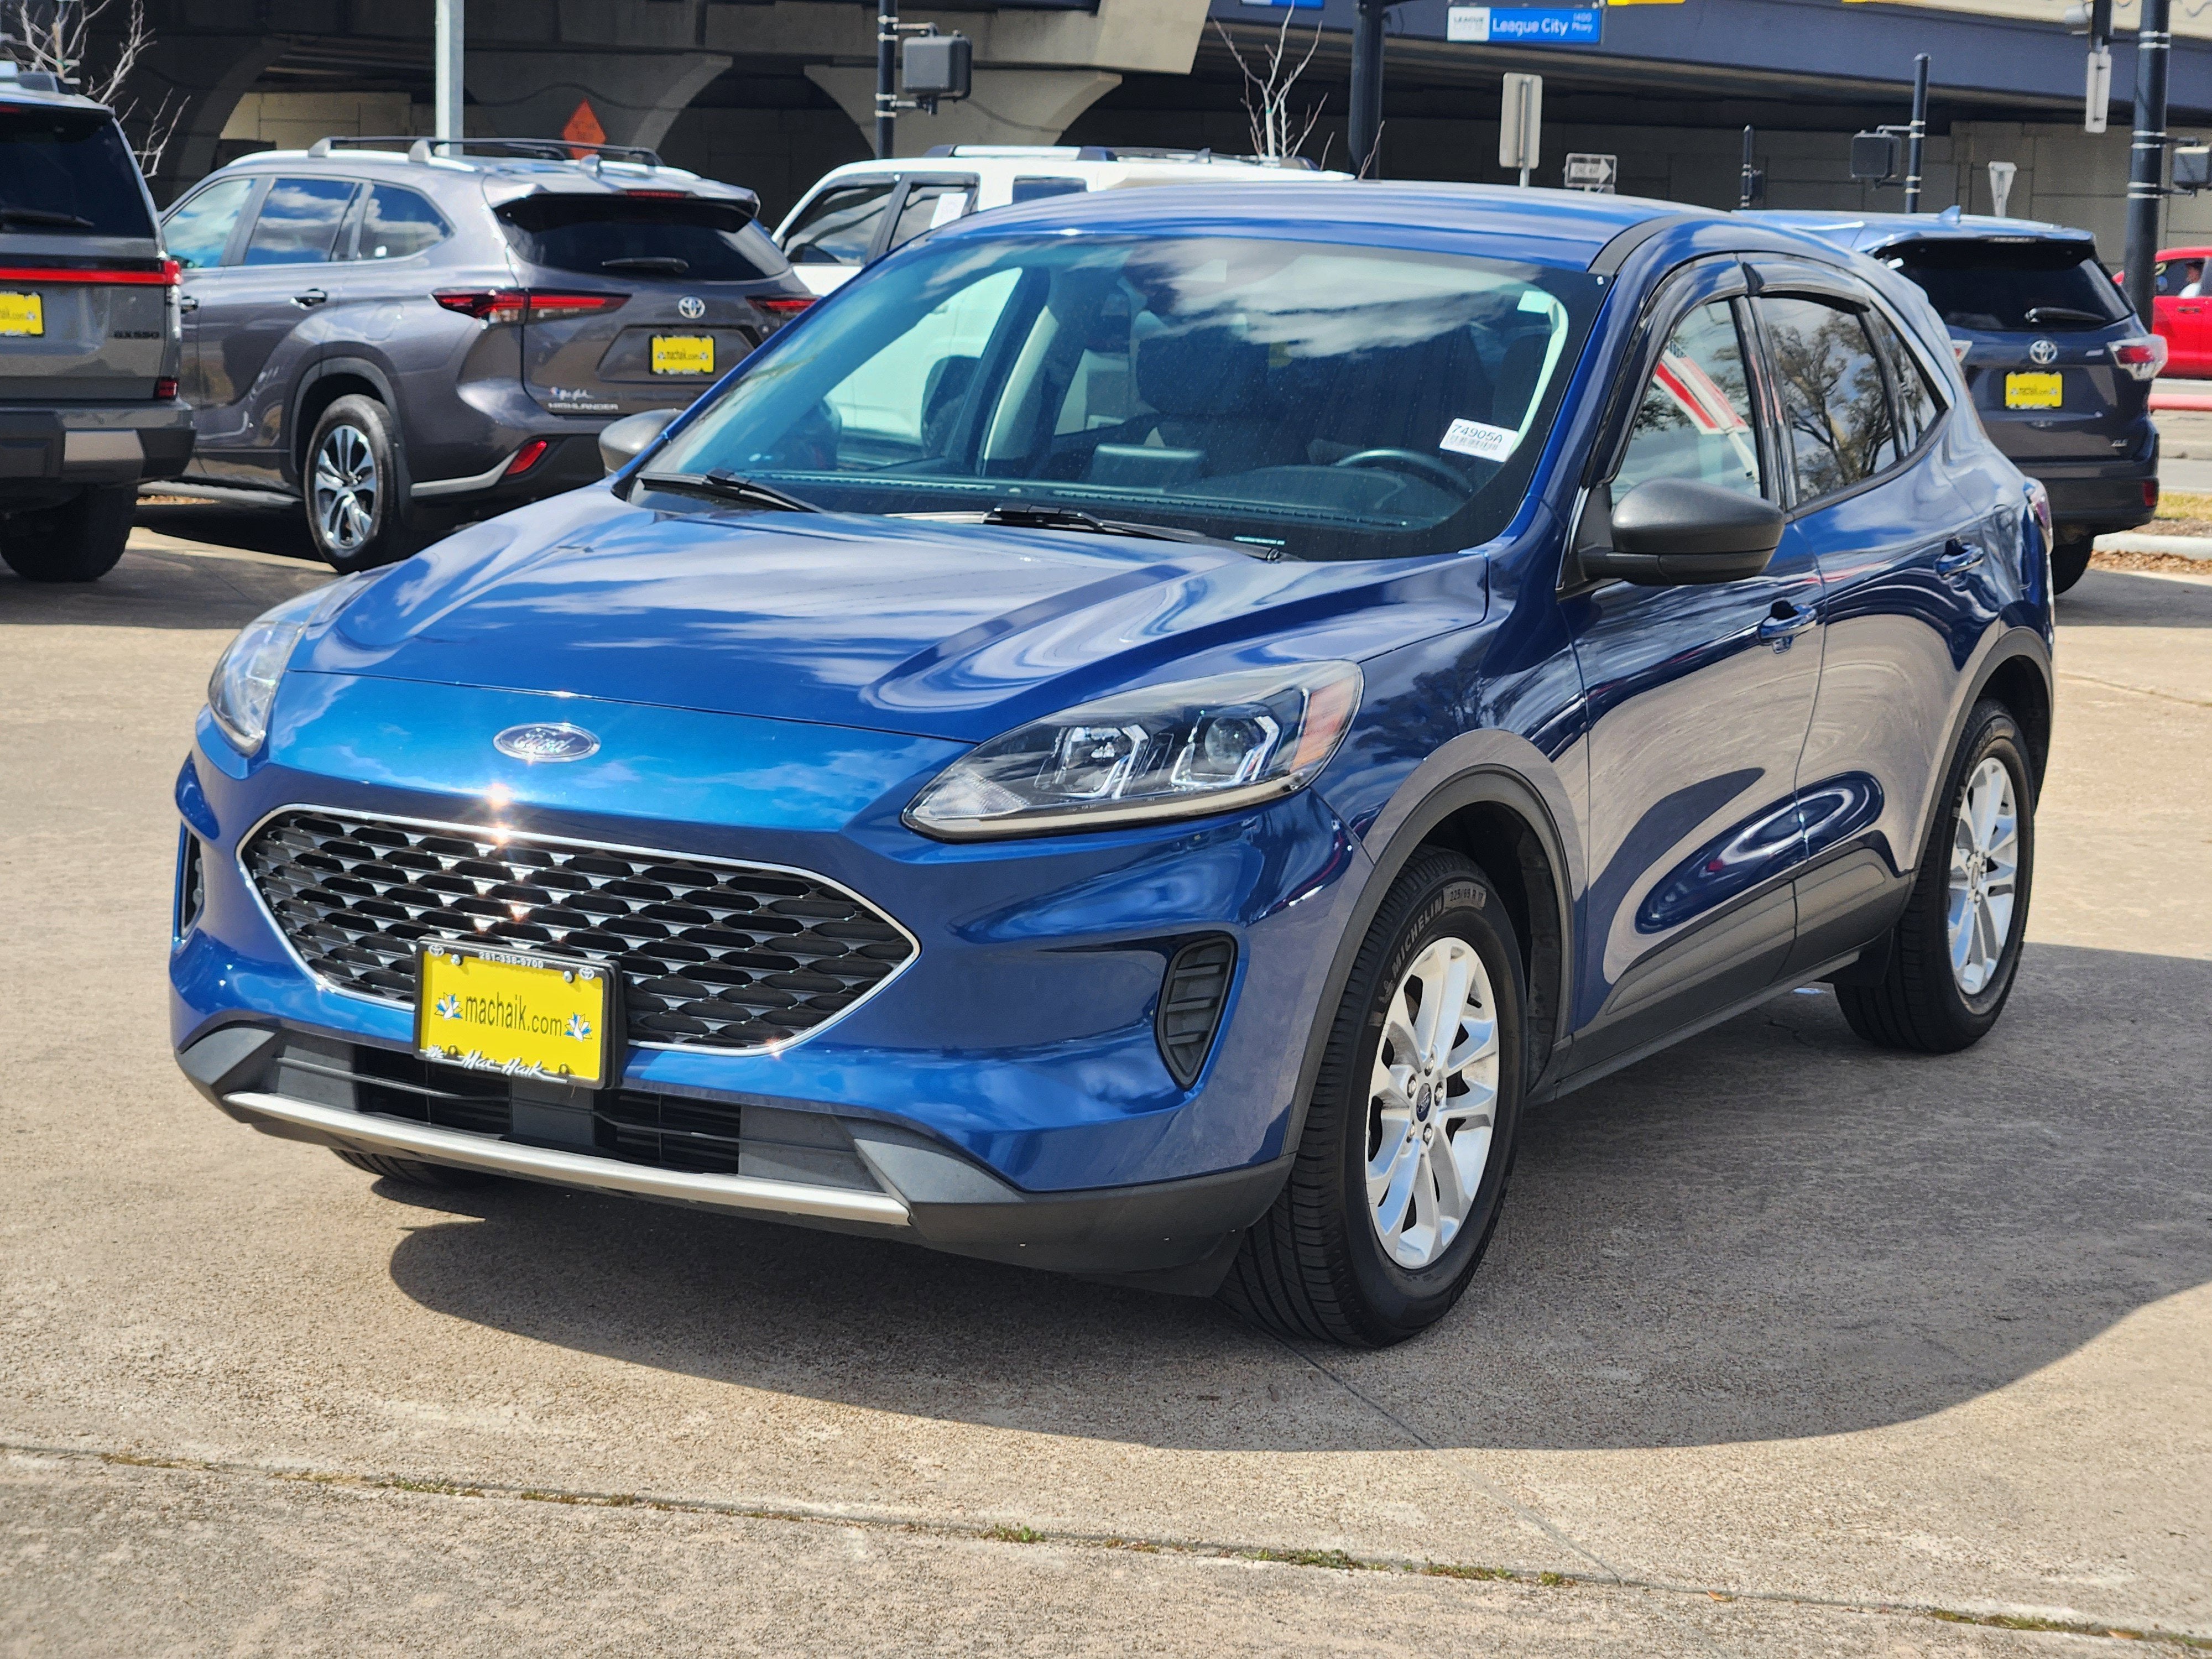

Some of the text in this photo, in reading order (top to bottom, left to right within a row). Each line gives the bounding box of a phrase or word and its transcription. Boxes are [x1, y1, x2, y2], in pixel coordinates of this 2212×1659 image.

[1493, 18, 1540, 37] League
[1541, 18, 1568, 36] City
[1452, 424, 1503, 444] 74905A
[514, 727, 577, 753] Ford
[1391, 896, 1444, 979] MICHELIN
[466, 992, 563, 1037] machaik.com
[462, 1050, 500, 1070] Mac
